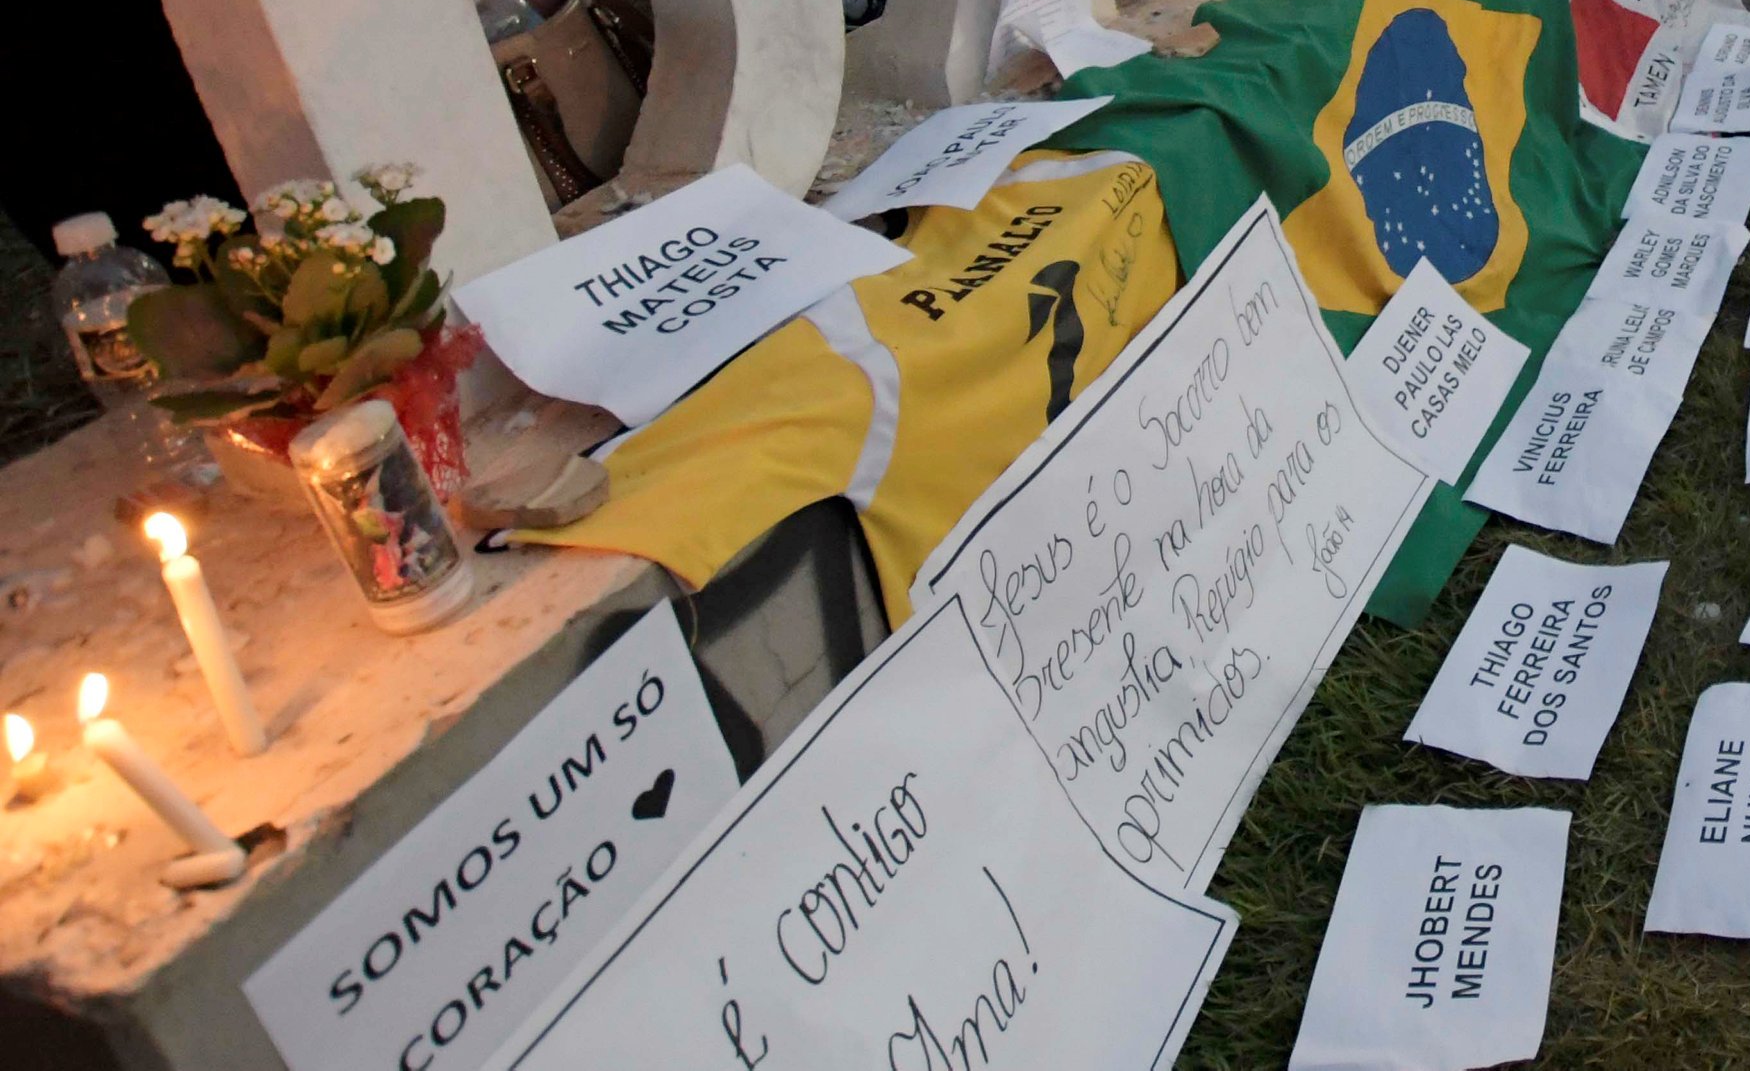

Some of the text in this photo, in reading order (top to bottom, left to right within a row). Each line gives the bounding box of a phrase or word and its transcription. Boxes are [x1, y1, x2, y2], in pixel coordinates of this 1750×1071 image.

[1633, 51, 1677, 111] TAMEN
[942, 106, 1017, 156] PAULO
[1346, 104, 1476, 165] ORDEM E PROGRESSO
[1651, 147, 1684, 207] ADNILSON
[1672, 145, 1711, 215] DA SILVA DO
[1693, 145, 1734, 220] NASCIMENTO
[573, 225, 720, 307] THIAGO
[602, 234, 762, 336] MATEUS
[656, 255, 788, 335] COSTA
[899, 204, 1065, 323] PLANALTO
[1623, 229, 1661, 279] WARLEY
[1651, 238, 1683, 279] GOMES
[1670, 233, 1711, 290] MARQUES
[1234, 278, 1280, 348] bem
[1382, 306, 1436, 375] DJENER
[1627, 308, 1676, 376] DE CAMPOS
[1394, 314, 1463, 411] PAULO LAS
[1410, 327, 1487, 439] CASAS MELO
[1512, 392, 1572, 476] VINICIUS
[1537, 388, 1604, 485] FERREIRA
[1154, 401, 1275, 571] na hora da
[1268, 397, 1342, 566] para os
[1468, 601, 1535, 690] THIAGO
[1497, 597, 1576, 721] FERREIRA
[1521, 583, 1614, 748] DOS SANTOS
[1699, 738, 1746, 845] ELIANE
[326, 670, 669, 1015] SOMOS UM SÓ
[398, 837, 622, 1071] CORAÇÃO
[1405, 854, 1463, 1009] JHOBERT
[1450, 862, 1504, 1001] MENDES
